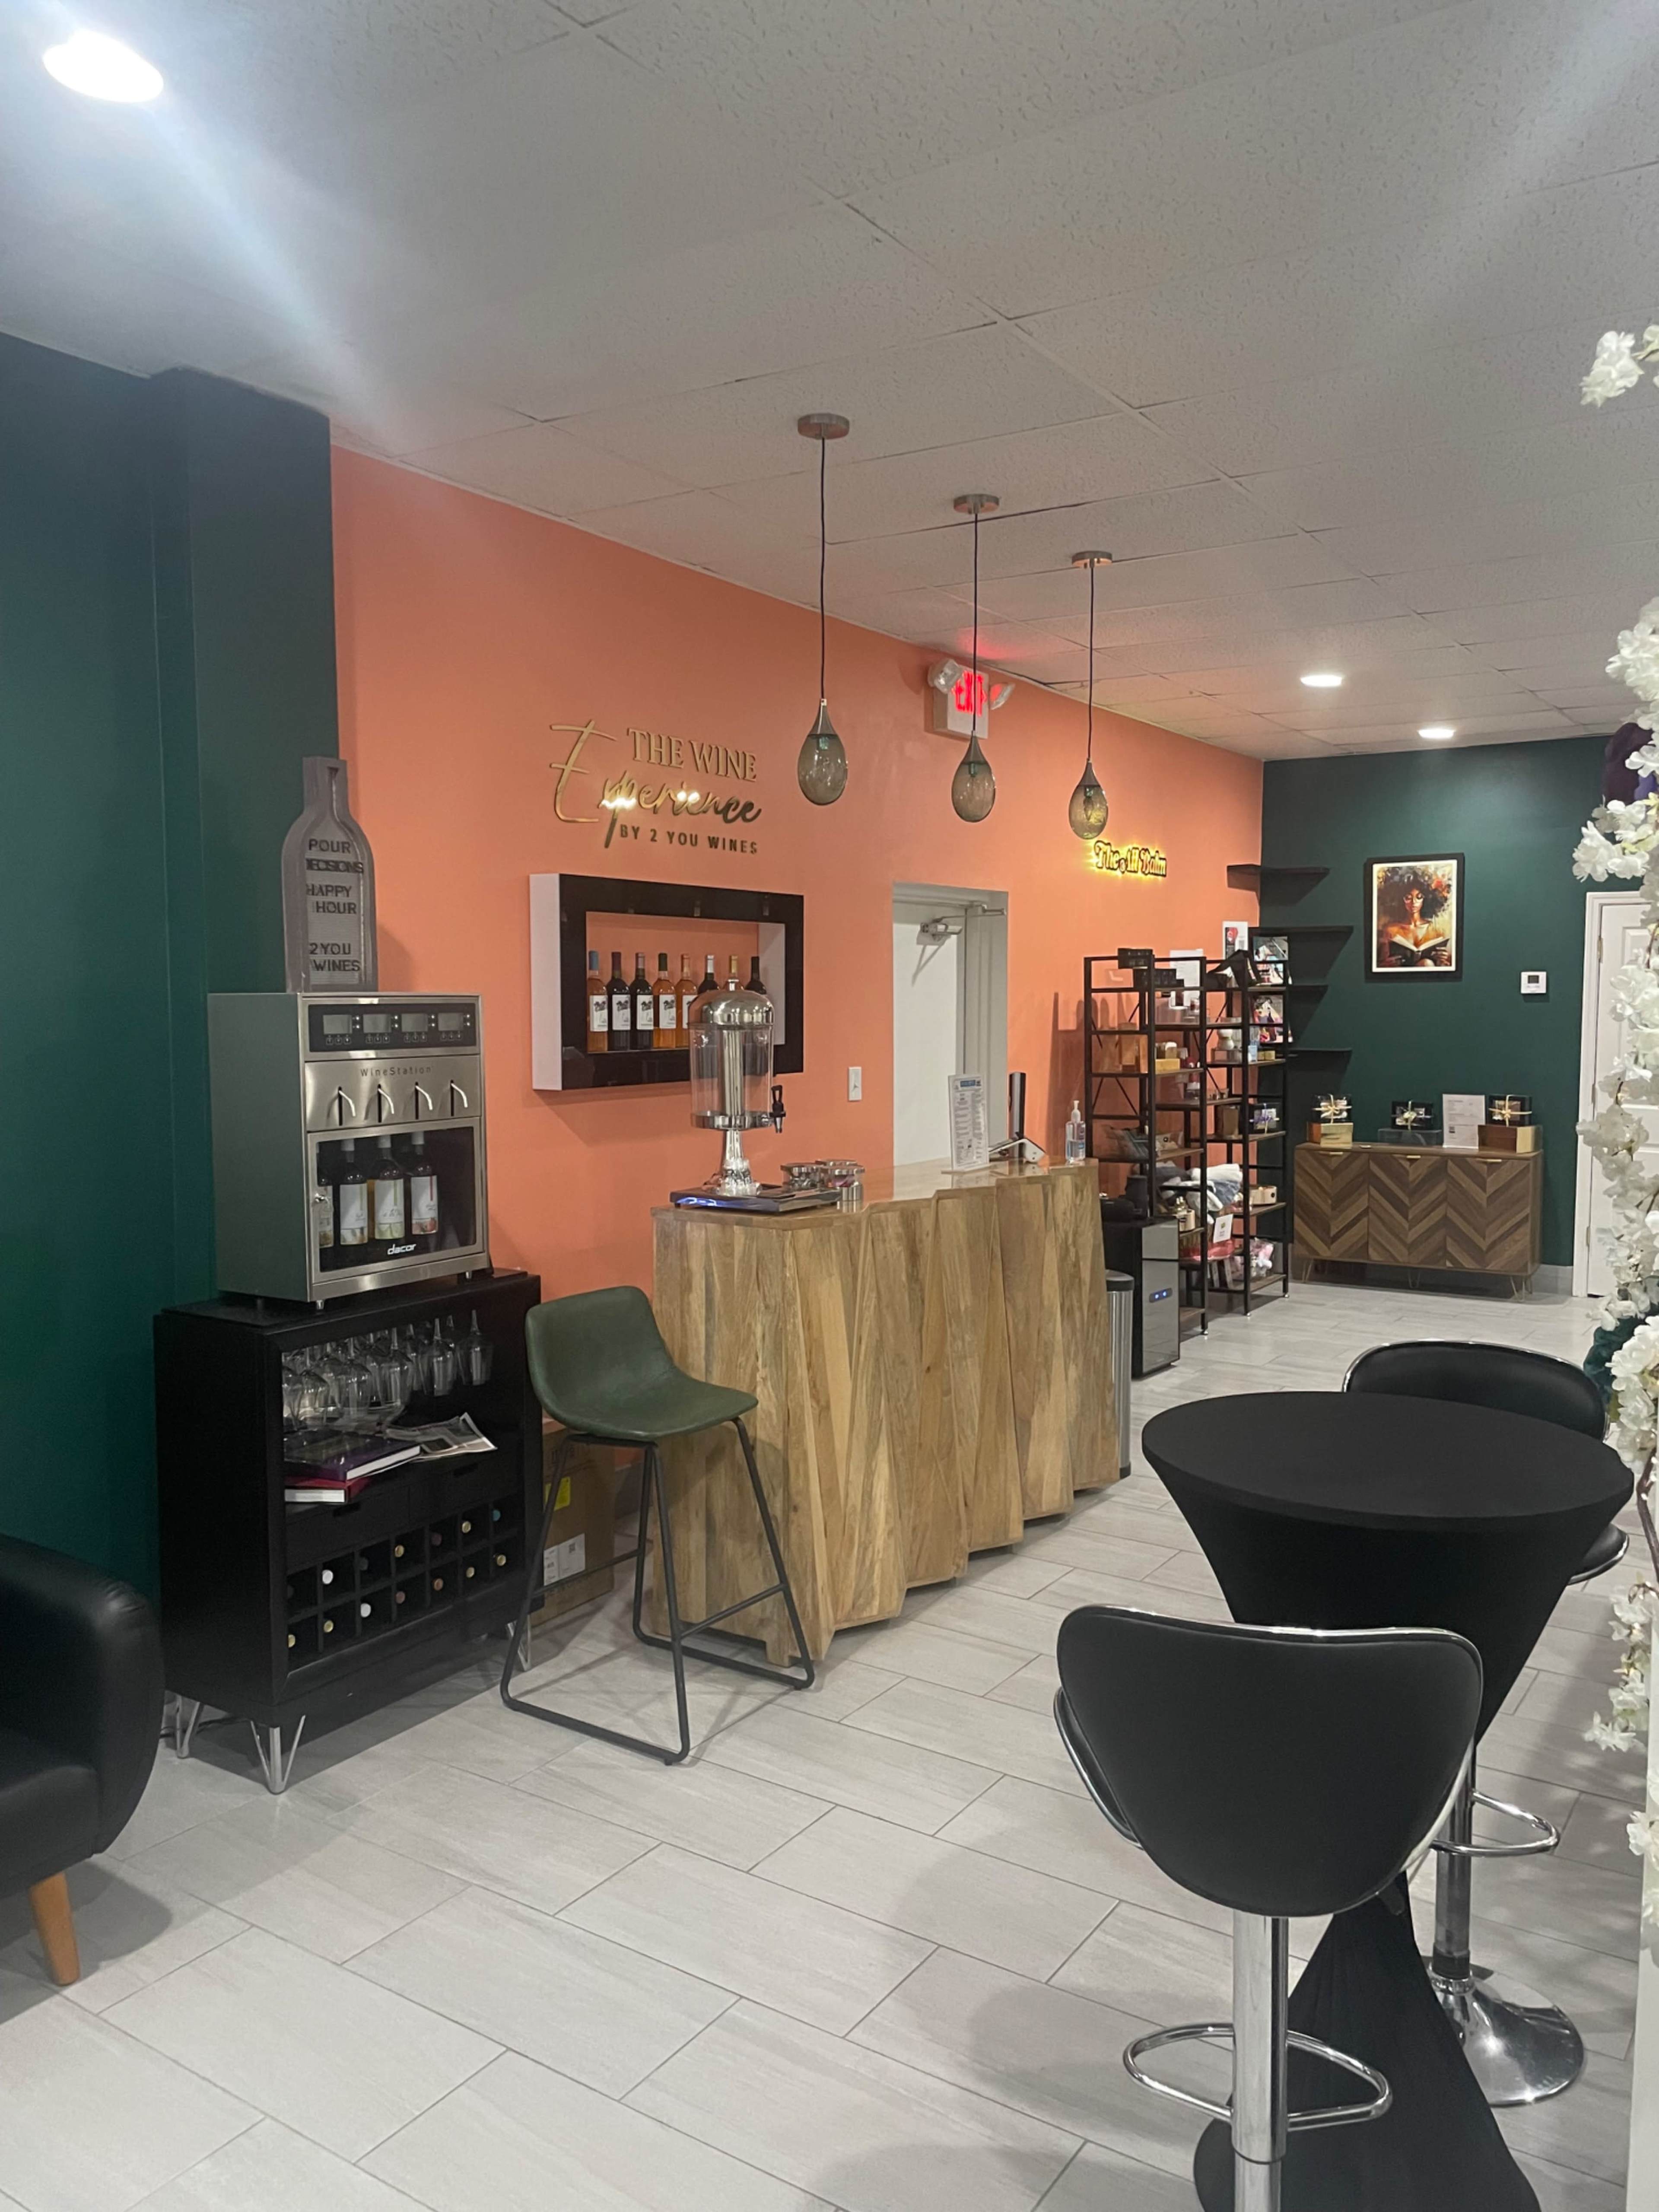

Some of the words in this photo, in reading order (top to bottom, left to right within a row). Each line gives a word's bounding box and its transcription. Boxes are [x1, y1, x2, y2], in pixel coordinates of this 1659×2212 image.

[627, 728, 684, 769] THE
[689, 739, 757, 781] WINE
[550, 719, 762, 849] Experience
[308, 838, 351, 854] POUR
[620, 824, 640, 840] BY
[650, 828, 658, 842] 2
[667, 831, 698, 847] YOU
[708, 835, 758, 855] WINES
[306, 884, 352, 898] HAPPY
[316, 900, 357, 914] HOUR
[311, 959, 361, 972] WINES
[360, 1066, 431, 1077] WineStation
[388, 1244, 416, 1255] dacor
